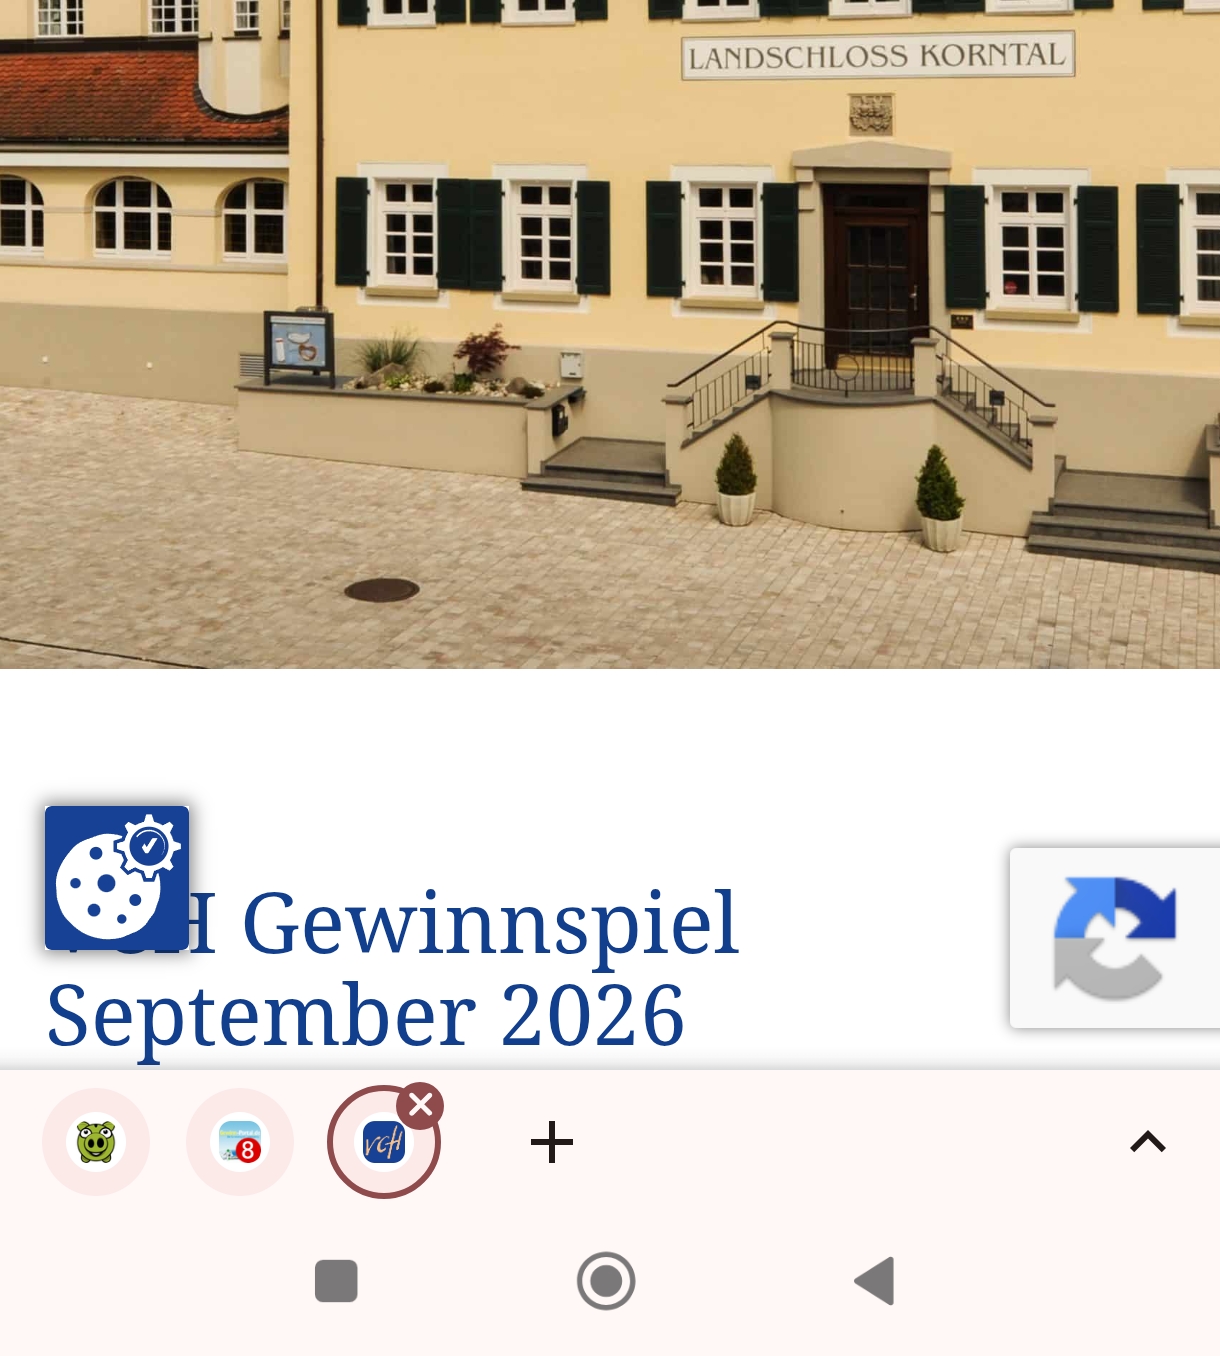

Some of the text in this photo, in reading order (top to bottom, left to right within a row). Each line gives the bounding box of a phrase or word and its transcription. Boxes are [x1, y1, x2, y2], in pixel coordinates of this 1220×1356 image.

[689, 42, 1067, 71] LANDSCHLOSS KORNTAL
[244, 888, 740, 974] Gewinnspiel
[48, 981, 684, 1065] September 2026
[241, 1140, 254, 1160] 8
